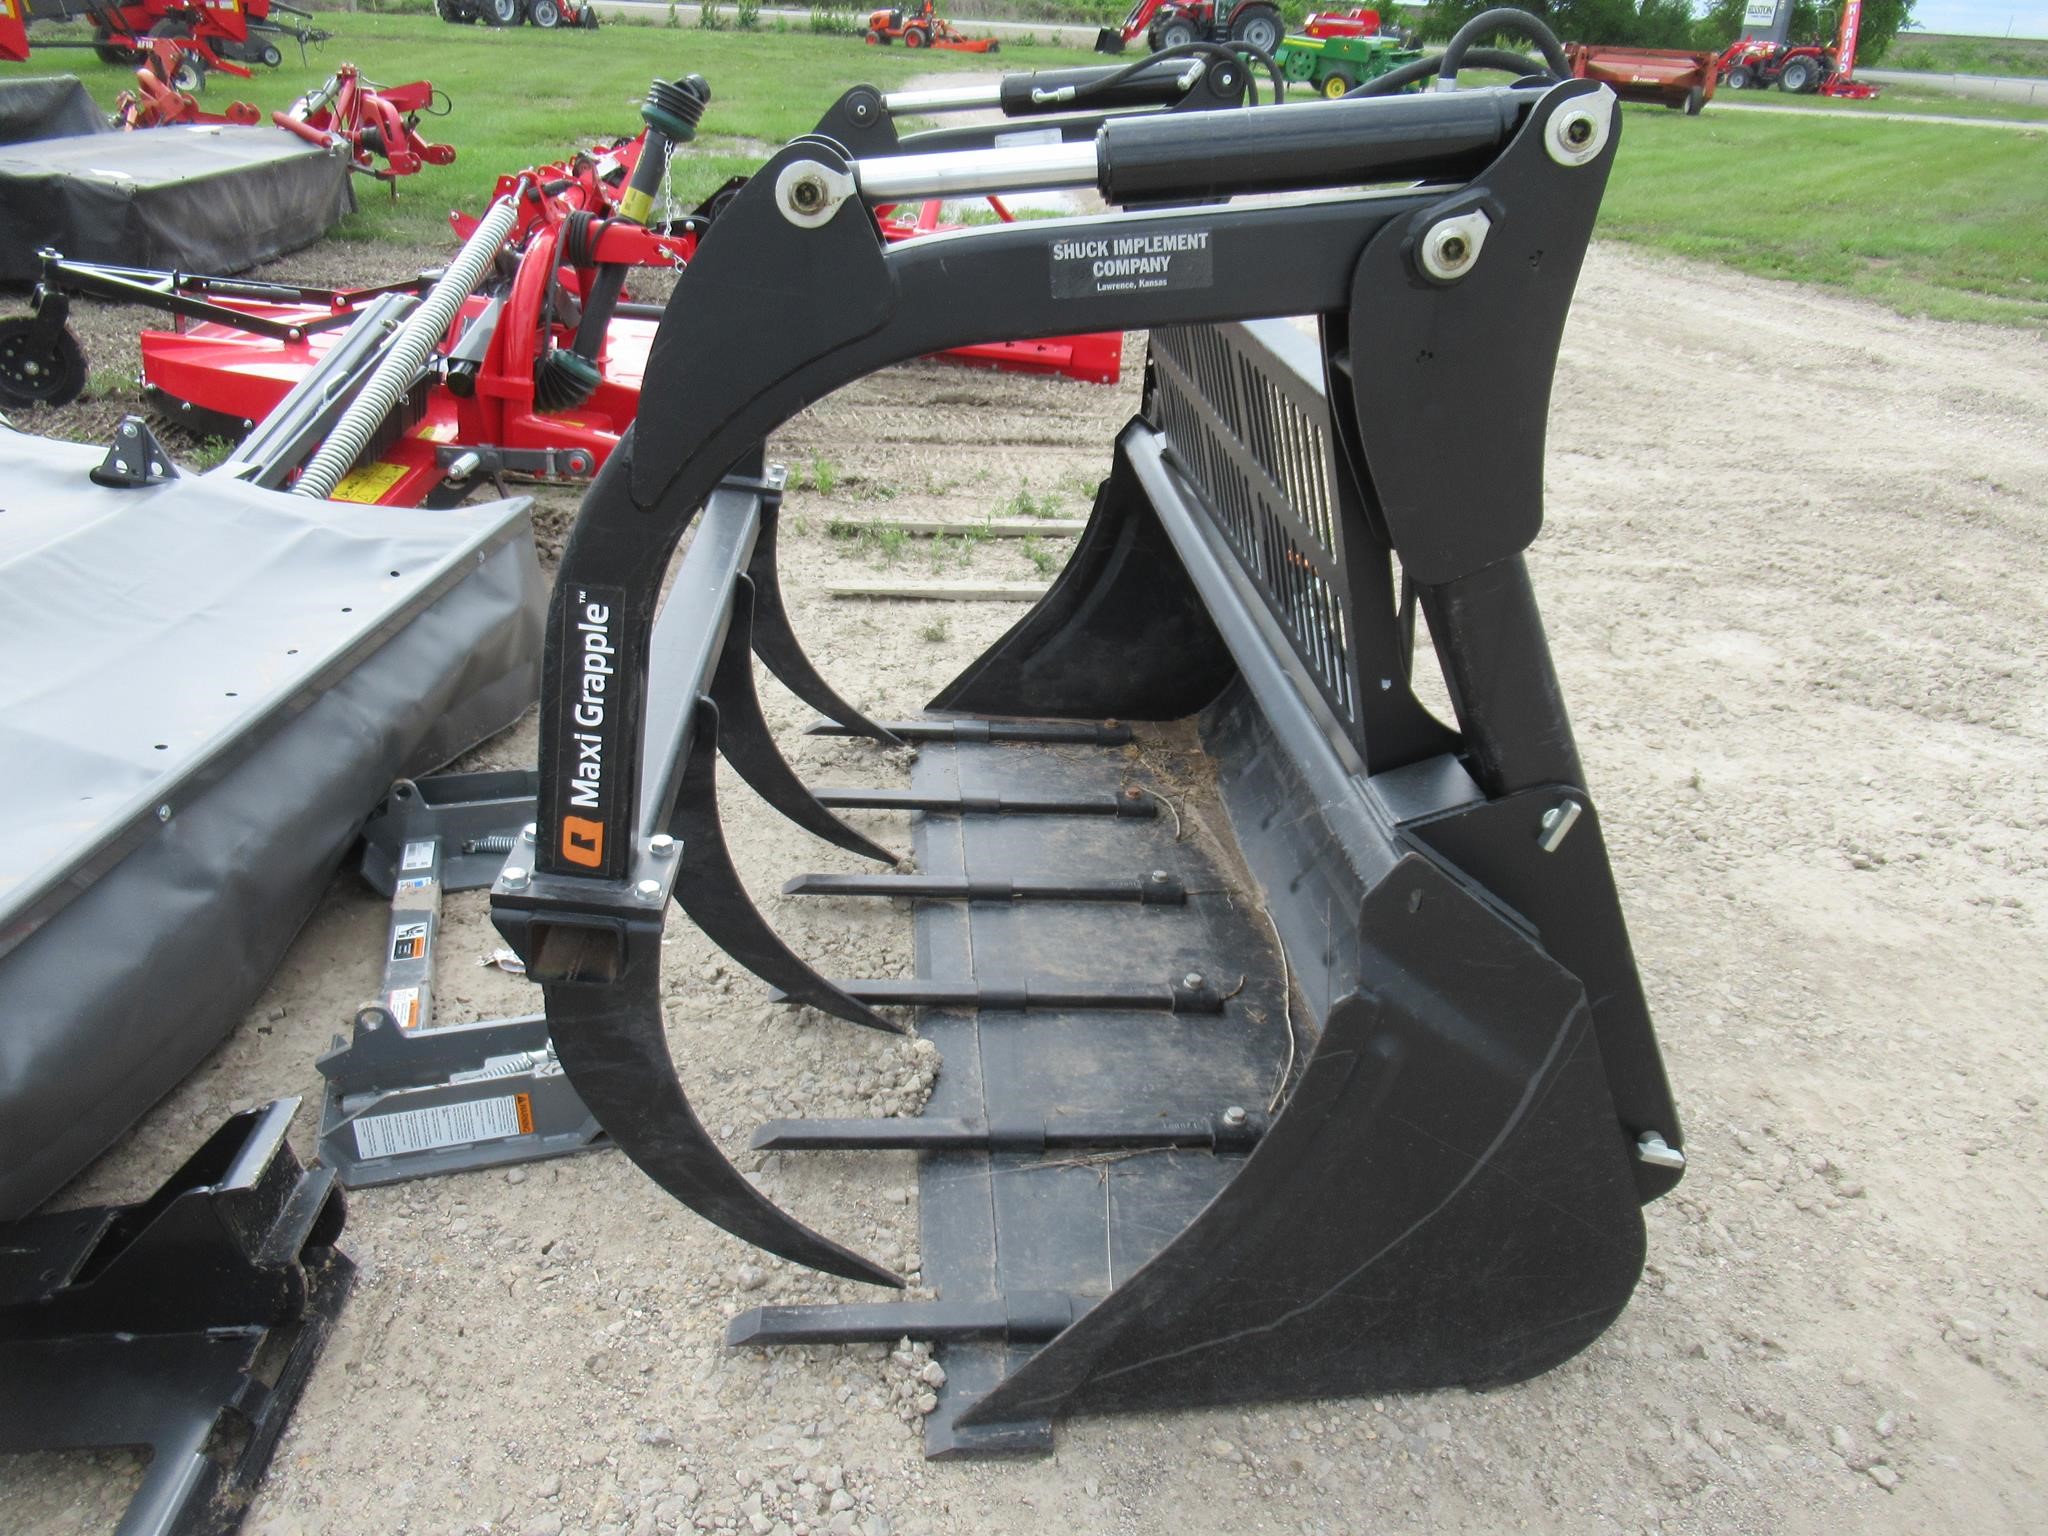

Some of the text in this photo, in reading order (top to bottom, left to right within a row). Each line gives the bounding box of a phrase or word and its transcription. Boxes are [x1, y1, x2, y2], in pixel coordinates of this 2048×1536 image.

[1053, 232, 1209, 261] SHUCK IMPLEMENT
[1092, 255, 1171, 278] COMPANY
[1097, 278, 1168, 292] Lawrence, Kansas
[571, 733, 603, 808] Maxi
